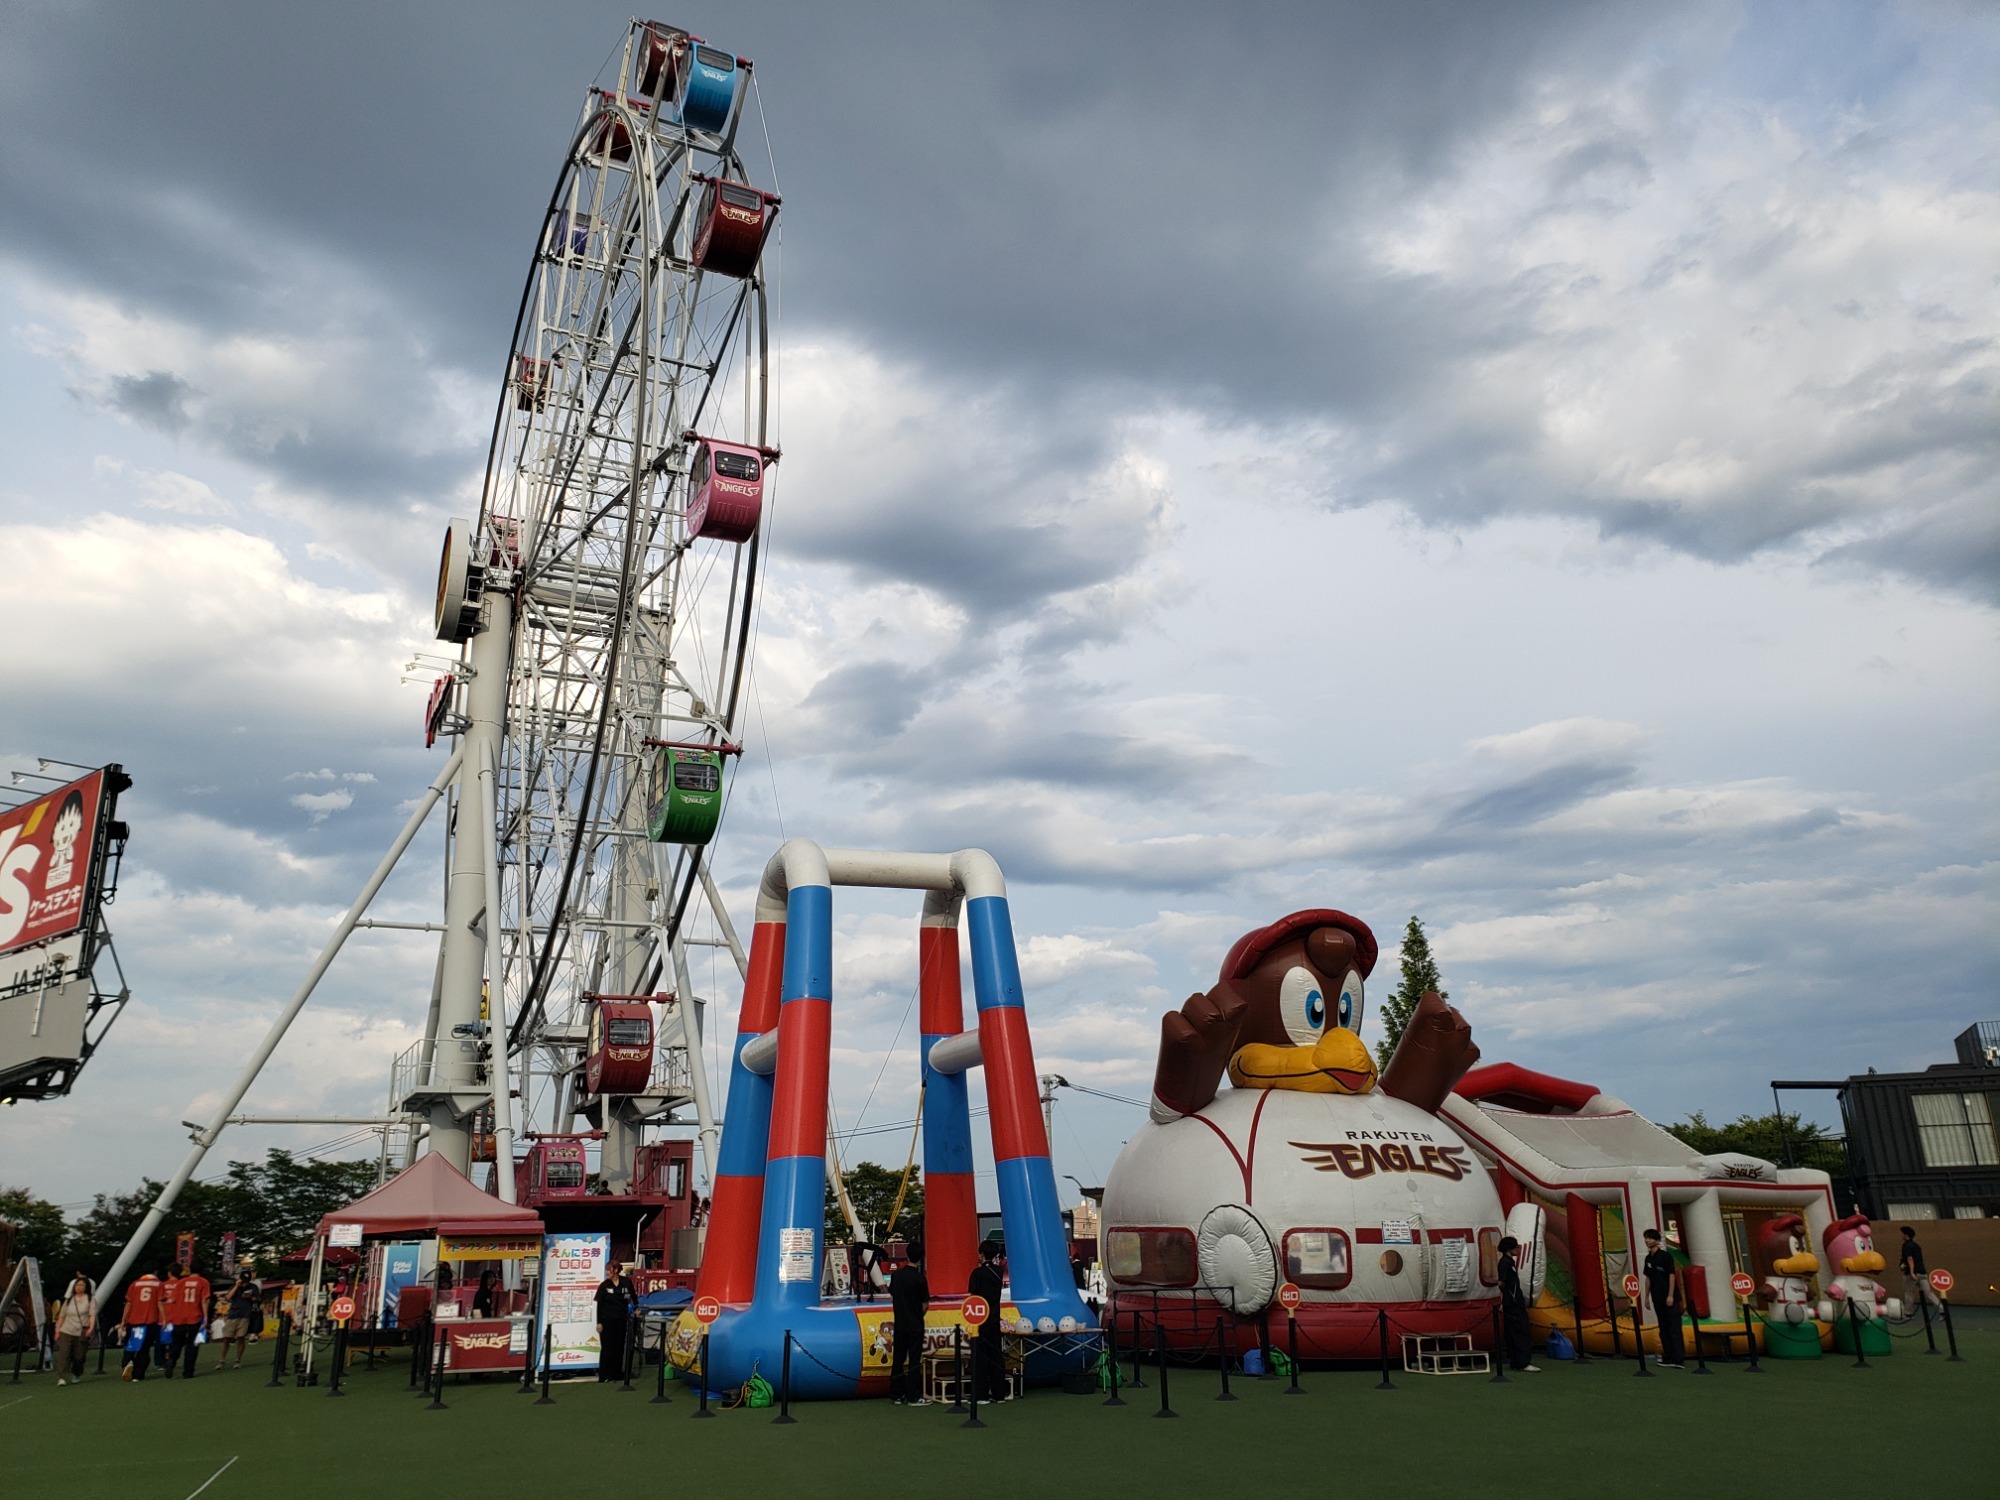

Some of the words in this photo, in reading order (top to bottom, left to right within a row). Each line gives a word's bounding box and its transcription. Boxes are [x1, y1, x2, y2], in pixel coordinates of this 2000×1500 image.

[720, 481, 756, 497] ANGELS
[29, 885, 82, 918] ケーズデンキ
[1345, 1131, 1434, 1142] RAKUTEN
[1322, 1143, 1465, 1182] EAGLES
[1728, 1167, 1759, 1179] EAGLES
[551, 1248, 601, 1258] えんにち券
[1733, 1280, 1751, 1289] 出口
[1932, 1275, 1950, 1284] 入口
[1627, 1281, 1638, 1291] 入口
[140, 1287, 152, 1302] 6
[184, 1288, 196, 1302] 11
[1282, 1291, 1299, 1301] 出口
[334, 1304, 352, 1313] 入口
[698, 1305, 717, 1316] 出口
[965, 1305, 985, 1316] 入口
[462, 1336, 505, 1350] EAGLES
[922, 1335, 970, 1351] EAGL
